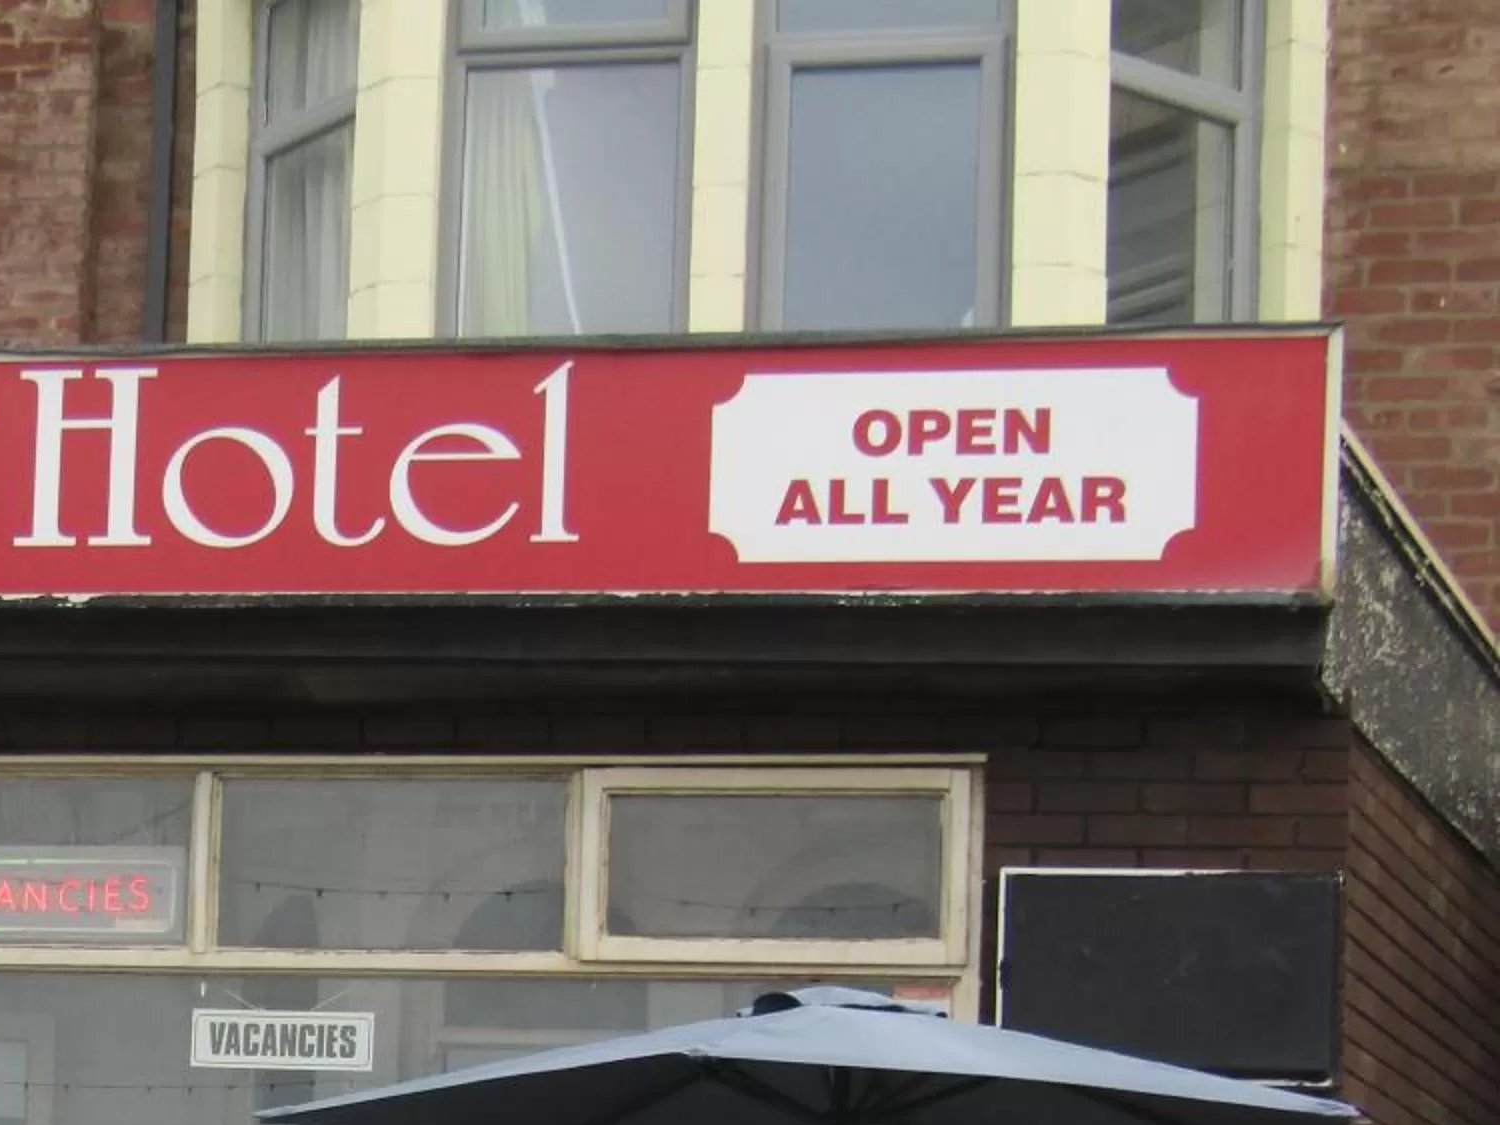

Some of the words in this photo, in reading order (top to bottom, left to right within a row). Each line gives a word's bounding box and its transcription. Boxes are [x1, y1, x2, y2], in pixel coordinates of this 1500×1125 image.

[13, 360, 581, 549] Hotel
[852, 407, 1052, 457] OPEN
[774, 478, 909, 526] ALL
[929, 476, 1127, 524] YEAR
[209, 1021, 357, 1059] VACANCIES
